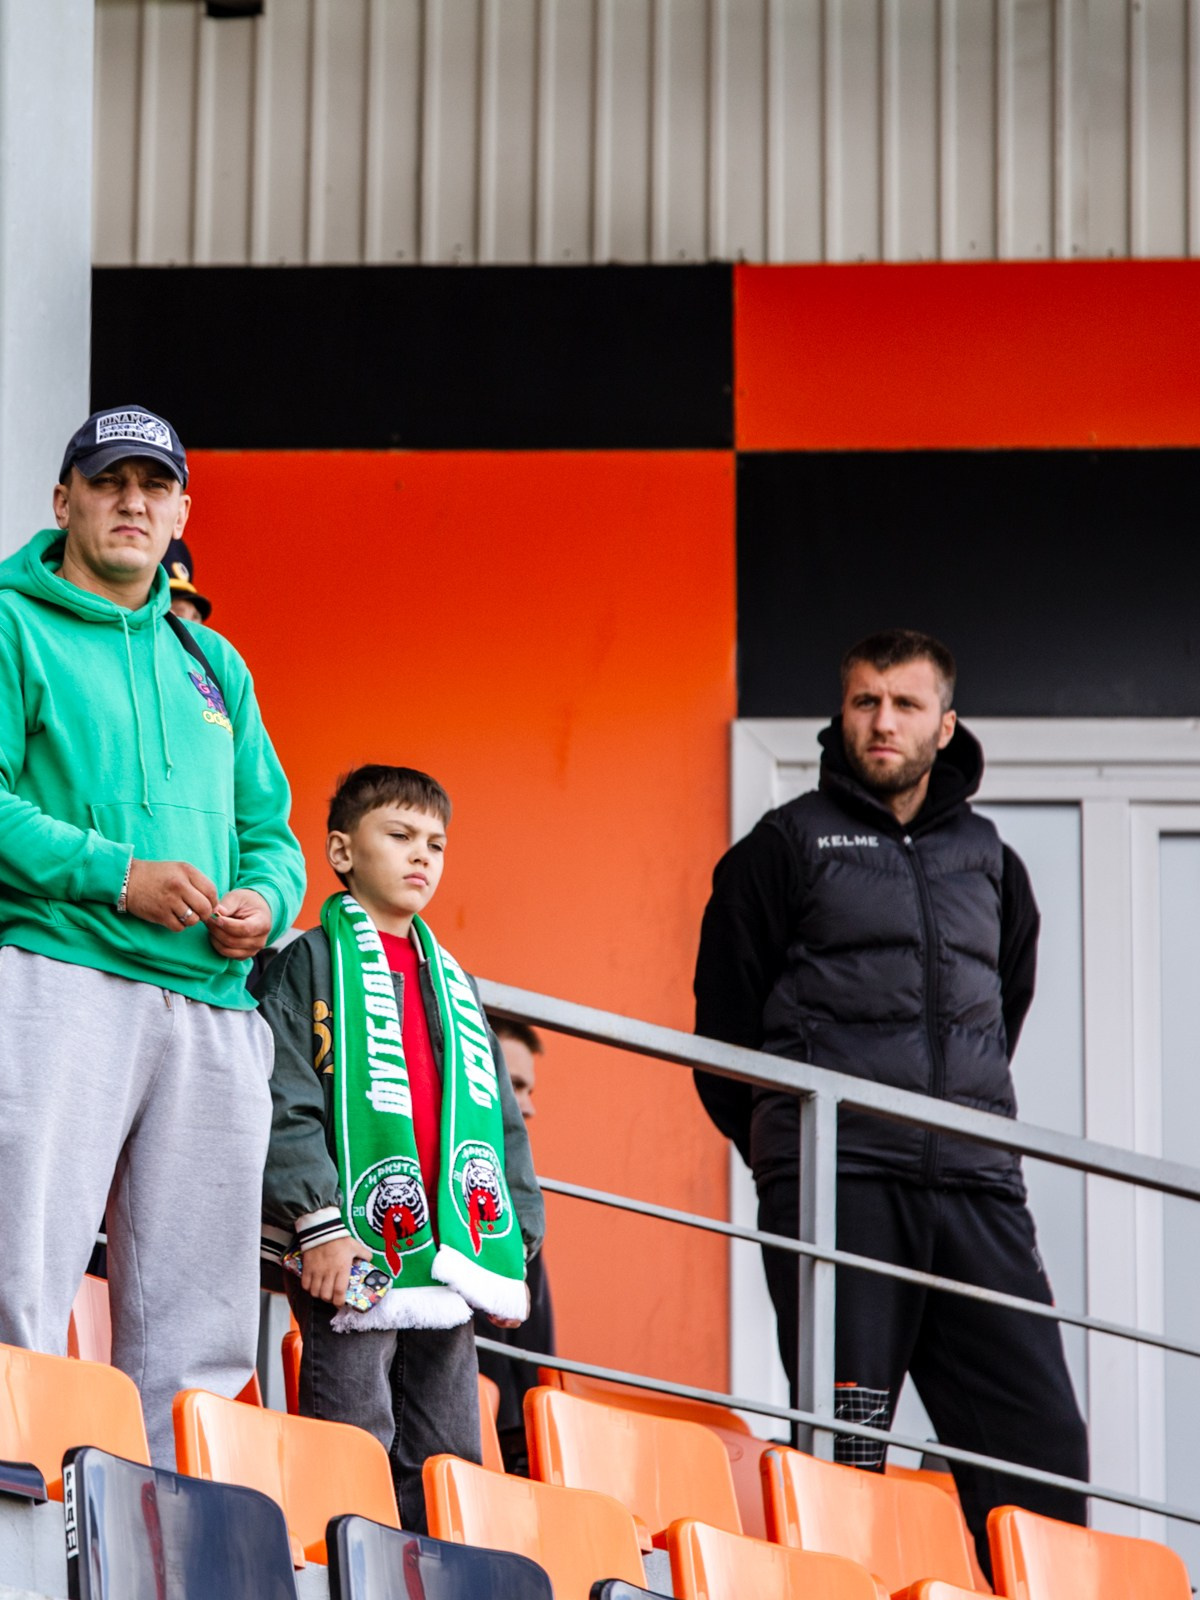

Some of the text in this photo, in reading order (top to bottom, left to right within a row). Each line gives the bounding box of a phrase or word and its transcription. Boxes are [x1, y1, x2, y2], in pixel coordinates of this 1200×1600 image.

[818, 834, 879, 849] KELME
[368, 1162, 422, 1185] ИРКУТС
[352, 1205, 365, 1216] 20
[66, 1471, 76, 1550] РЯД 11
